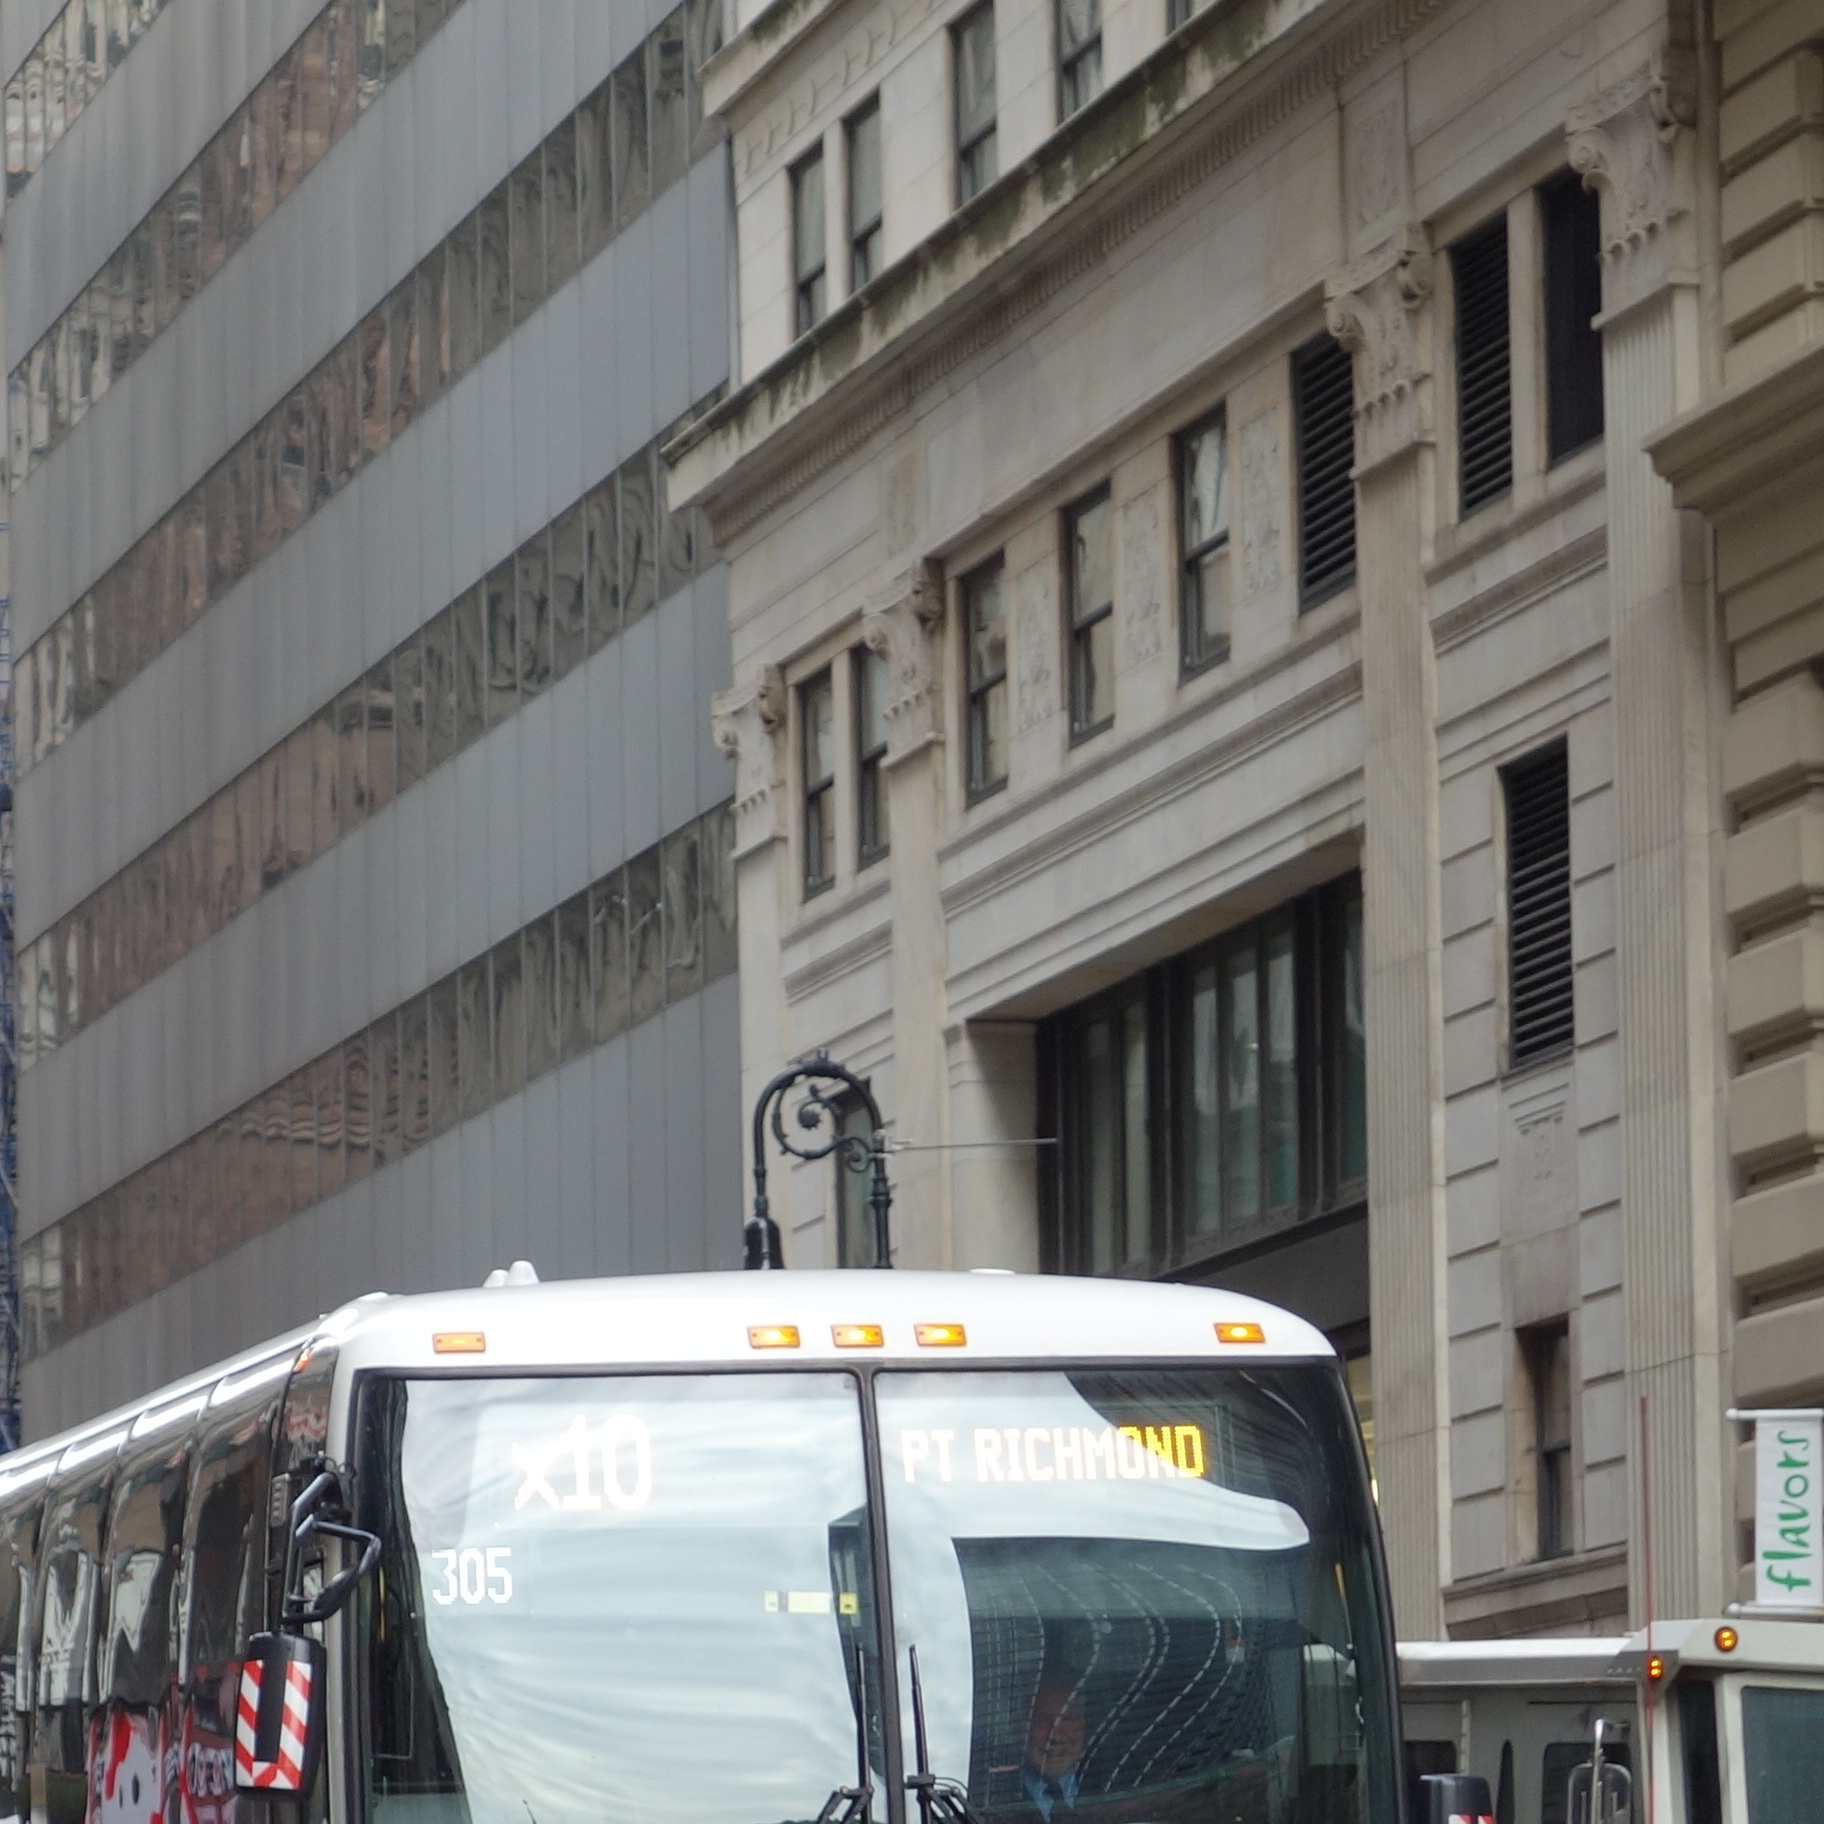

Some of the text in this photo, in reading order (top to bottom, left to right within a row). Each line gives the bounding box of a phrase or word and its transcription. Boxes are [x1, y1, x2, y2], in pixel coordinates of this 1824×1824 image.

[899, 1424, 1205, 1483] PT RICHMOND
[1760, 1430, 1814, 1593] flavors
[431, 1546, 513, 1605] 305
